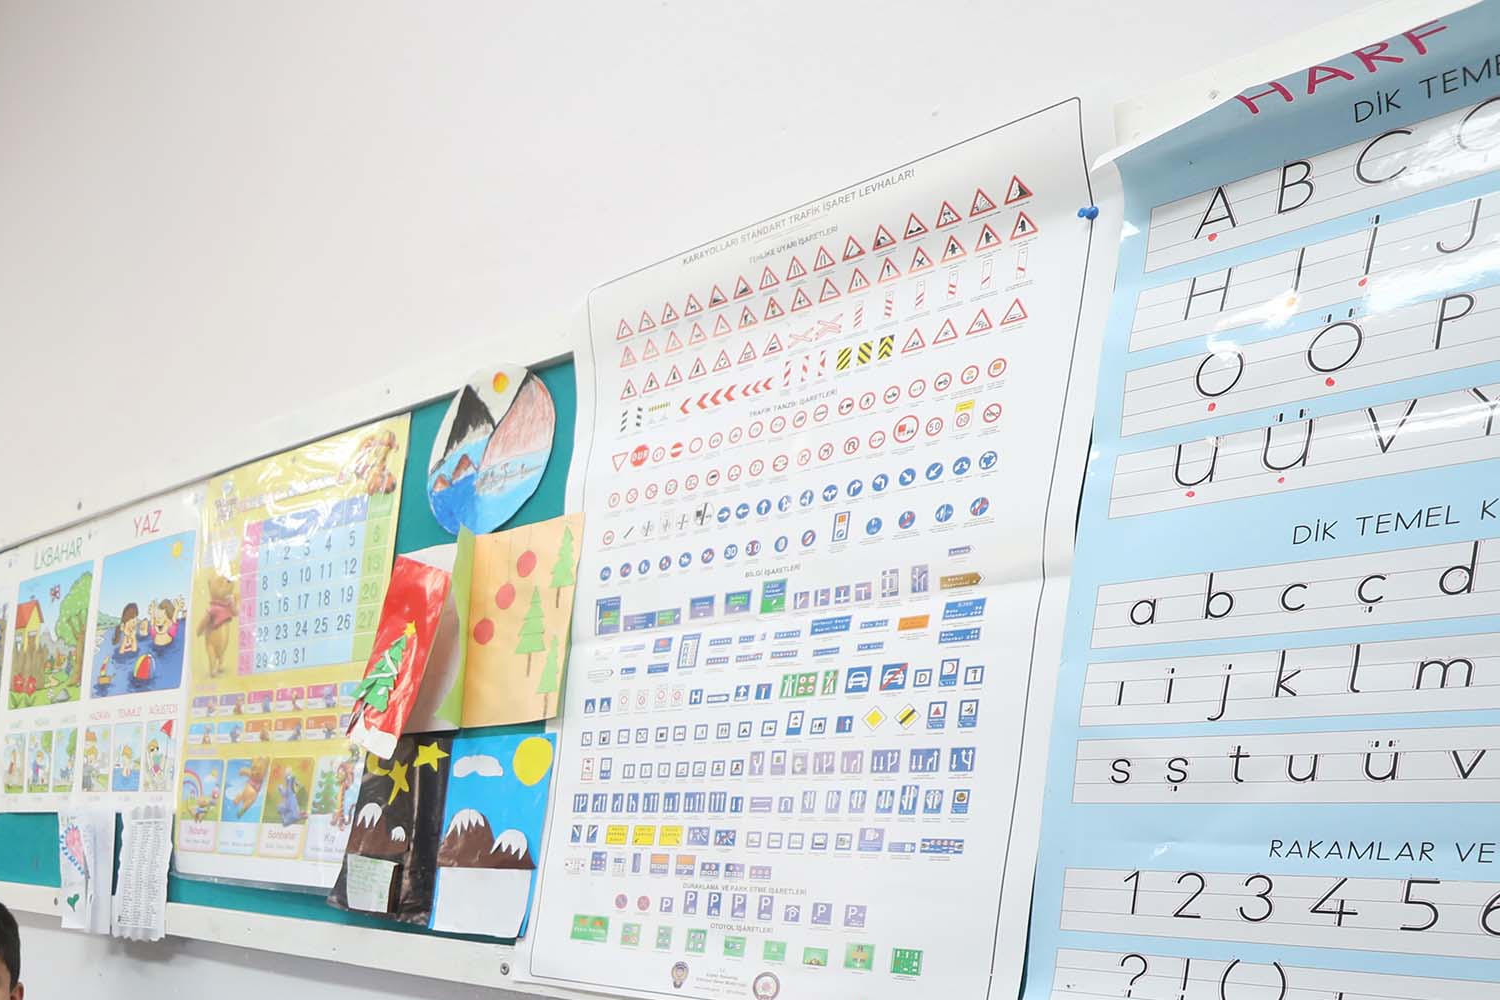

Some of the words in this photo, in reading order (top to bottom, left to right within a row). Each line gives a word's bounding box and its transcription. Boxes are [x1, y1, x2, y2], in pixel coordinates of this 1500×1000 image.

[1236, 19, 1448, 115] HARF
[1354, 89, 1401, 123] DİK
[1194, 186, 1238, 239] A
[1277, 160, 1314, 214] B
[1356, 130, 1412, 184] C
[682, 237, 739, 265] KARAYOLLARI
[740, 218, 787, 243] STANDART
[788, 204, 821, 224] TRAFİK
[822, 191, 856, 213] İŞARET
[858, 168, 916, 198] LEVHALARI
[1184, 267, 1233, 320] H
[1437, 198, 1482, 254] J
[1195, 351, 1244, 397] O
[1308, 308, 1362, 373] Ö
[1435, 293, 1475, 350] P
[1368, 399, 1417, 453] V
[133, 509, 163, 537] YAZ
[325, 535, 333, 552] 4
[349, 530, 356, 547] 5
[1293, 517, 1338, 545] DİK
[1356, 504, 1461, 536] TEMEL
[262, 575, 269, 591] 8
[281, 571, 289, 587] 9
[300, 566, 312, 583] 10
[320, 562, 333, 579] 11
[344, 557, 357, 576] 12
[1129, 598, 1157, 625] a
[1203, 572, 1233, 619] b
[1281, 583, 1308, 612] c
[1357, 574, 1387, 614] ç
[1438, 541, 1480, 594] d
[259, 600, 270, 617] 15
[277, 596, 289, 613] 16
[297, 592, 310, 609] 17
[318, 589, 331, 606] 18
[340, 585, 354, 603] 19
[275, 623, 289, 640] 23
[295, 619, 308, 637] 24
[314, 616, 329, 633] 25
[336, 613, 352, 631] 26
[293, 647, 306, 664] 31
[1165, 666, 1176, 704] i
[1207, 663, 1232, 722] j
[1274, 649, 1302, 698] k
[1414, 657, 1474, 690] m
[1110, 757, 1132, 784] s
[1166, 757, 1189, 792] ş
[1229, 745, 1250, 783] t
[1286, 753, 1319, 783] u
[1364, 740, 1399, 781] ü
[1452, 749, 1487, 779] v
[1269, 838, 1435, 862] RAKAMLAR
[1455, 841, 1496, 864] VE
[1123, 870, 1140, 915] 1
[1172, 872, 1206, 918] 2
[1239, 874, 1274, 922] 3
[1309, 876, 1358, 927] 4
[1400, 877, 1441, 931] 5
